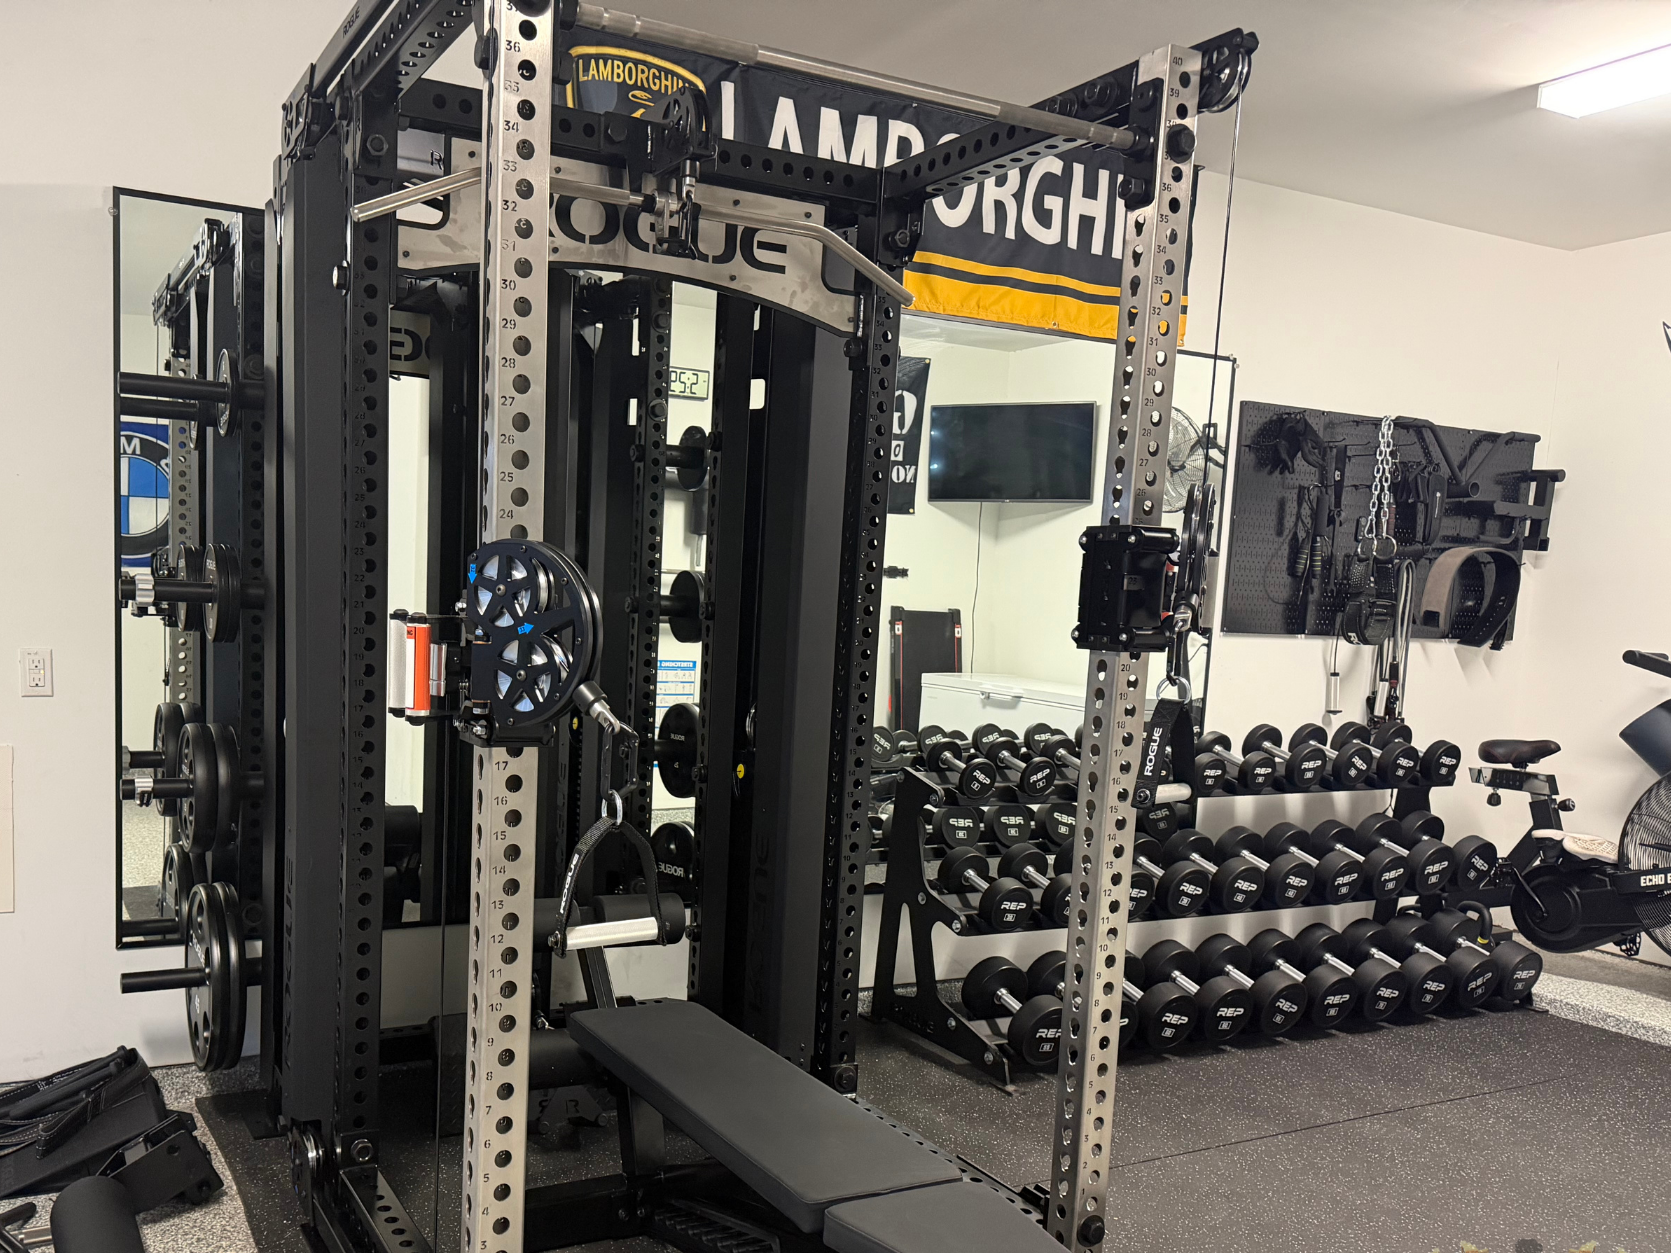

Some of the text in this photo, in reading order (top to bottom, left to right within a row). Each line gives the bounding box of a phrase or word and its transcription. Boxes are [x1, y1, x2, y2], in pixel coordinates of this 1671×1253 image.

[342, 6, 361, 38] ROGUE
[505, 40, 521, 52] 36
[1173, 57, 1182, 66] 40
[1170, 88, 1179, 98] 39
[504, 121, 519, 133] 34
[503, 160, 517, 172] 33
[1162, 183, 1172, 192] 36
[502, 201, 517, 212] 32
[1159, 214, 1169, 223] 35
[547, 189, 787, 275] OGUE
[1157, 245, 1166, 254] 34
[501, 279, 516, 291] 30
[1154, 276, 1163, 285] 33
[1152, 307, 1161, 316] 32
[502, 319, 516, 330] 29
[1149, 338, 1158, 346] 31
[501, 358, 516, 368] 28
[1146, 368, 1156, 376] 30
[501, 396, 515, 406] 27
[1144, 398, 1153, 407] 29
[1142, 428, 1151, 436] 28
[500, 434, 514, 444] 26
[1139, 459, 1148, 467] 27
[500, 472, 513, 482] 25
[1136, 489, 1146, 497] 26
[499, 509, 513, 519] 24
[1121, 664, 1131, 672] 20
[1119, 692, 1128, 700] 19
[1116, 721, 1126, 729] 18
[1114, 749, 1123, 757] 17
[1144, 727, 1163, 776] ROGUE
[1301, 760, 1322, 769] REP
[1352, 756, 1367, 770] REP
[1397, 758, 1414, 767] REP
[1440, 756, 1456, 765] REP
[495, 761, 508, 771] 17
[973, 770, 991, 784] REP
[1030, 769, 1050, 783] REP
[1112, 777, 1121, 785] 16
[494, 796, 508, 805] 16
[1109, 805, 1118, 813] 15
[493, 831, 506, 840] 15
[1105, 861, 1114, 869] 13
[1424, 861, 1448, 874] REP
[1471, 855, 1488, 871] REP
[493, 866, 506, 875] 14
[1381, 868, 1404, 881] REP
[1286, 876, 1307, 887] REP
[1335, 873, 1358, 885] REP
[1640, 877, 1664, 889] ECHO
[1180, 883, 1202, 895] REP
[1235, 880, 1257, 891] REP
[491, 901, 504, 909] 13
[1001, 902, 1026, 910] REP
[1100, 917, 1109, 925] 11
[491, 935, 504, 943] 12
[490, 969, 502, 978] 11
[1514, 970, 1535, 979] REP
[1423, 981, 1445, 991] REP
[1468, 972, 1492, 991] REP
[1377, 987, 1399, 998] REP
[1324, 994, 1350, 1005] REP
[489, 1003, 502, 1012] 10
[1275, 999, 1297, 1012] REP
[1217, 1008, 1244, 1016] REP
[1162, 1013, 1188, 1025] REP
[1093, 1026, 1097, 1034] 7
[488, 1038, 494, 1047] 9
[486, 1072, 493, 1081] 8
[486, 1106, 492, 1114] 7
[484, 1140, 491, 1149] 6
[483, 1174, 489, 1182] 5
[482, 1207, 489, 1215] 4
[481, 1241, 486, 1249] 3
